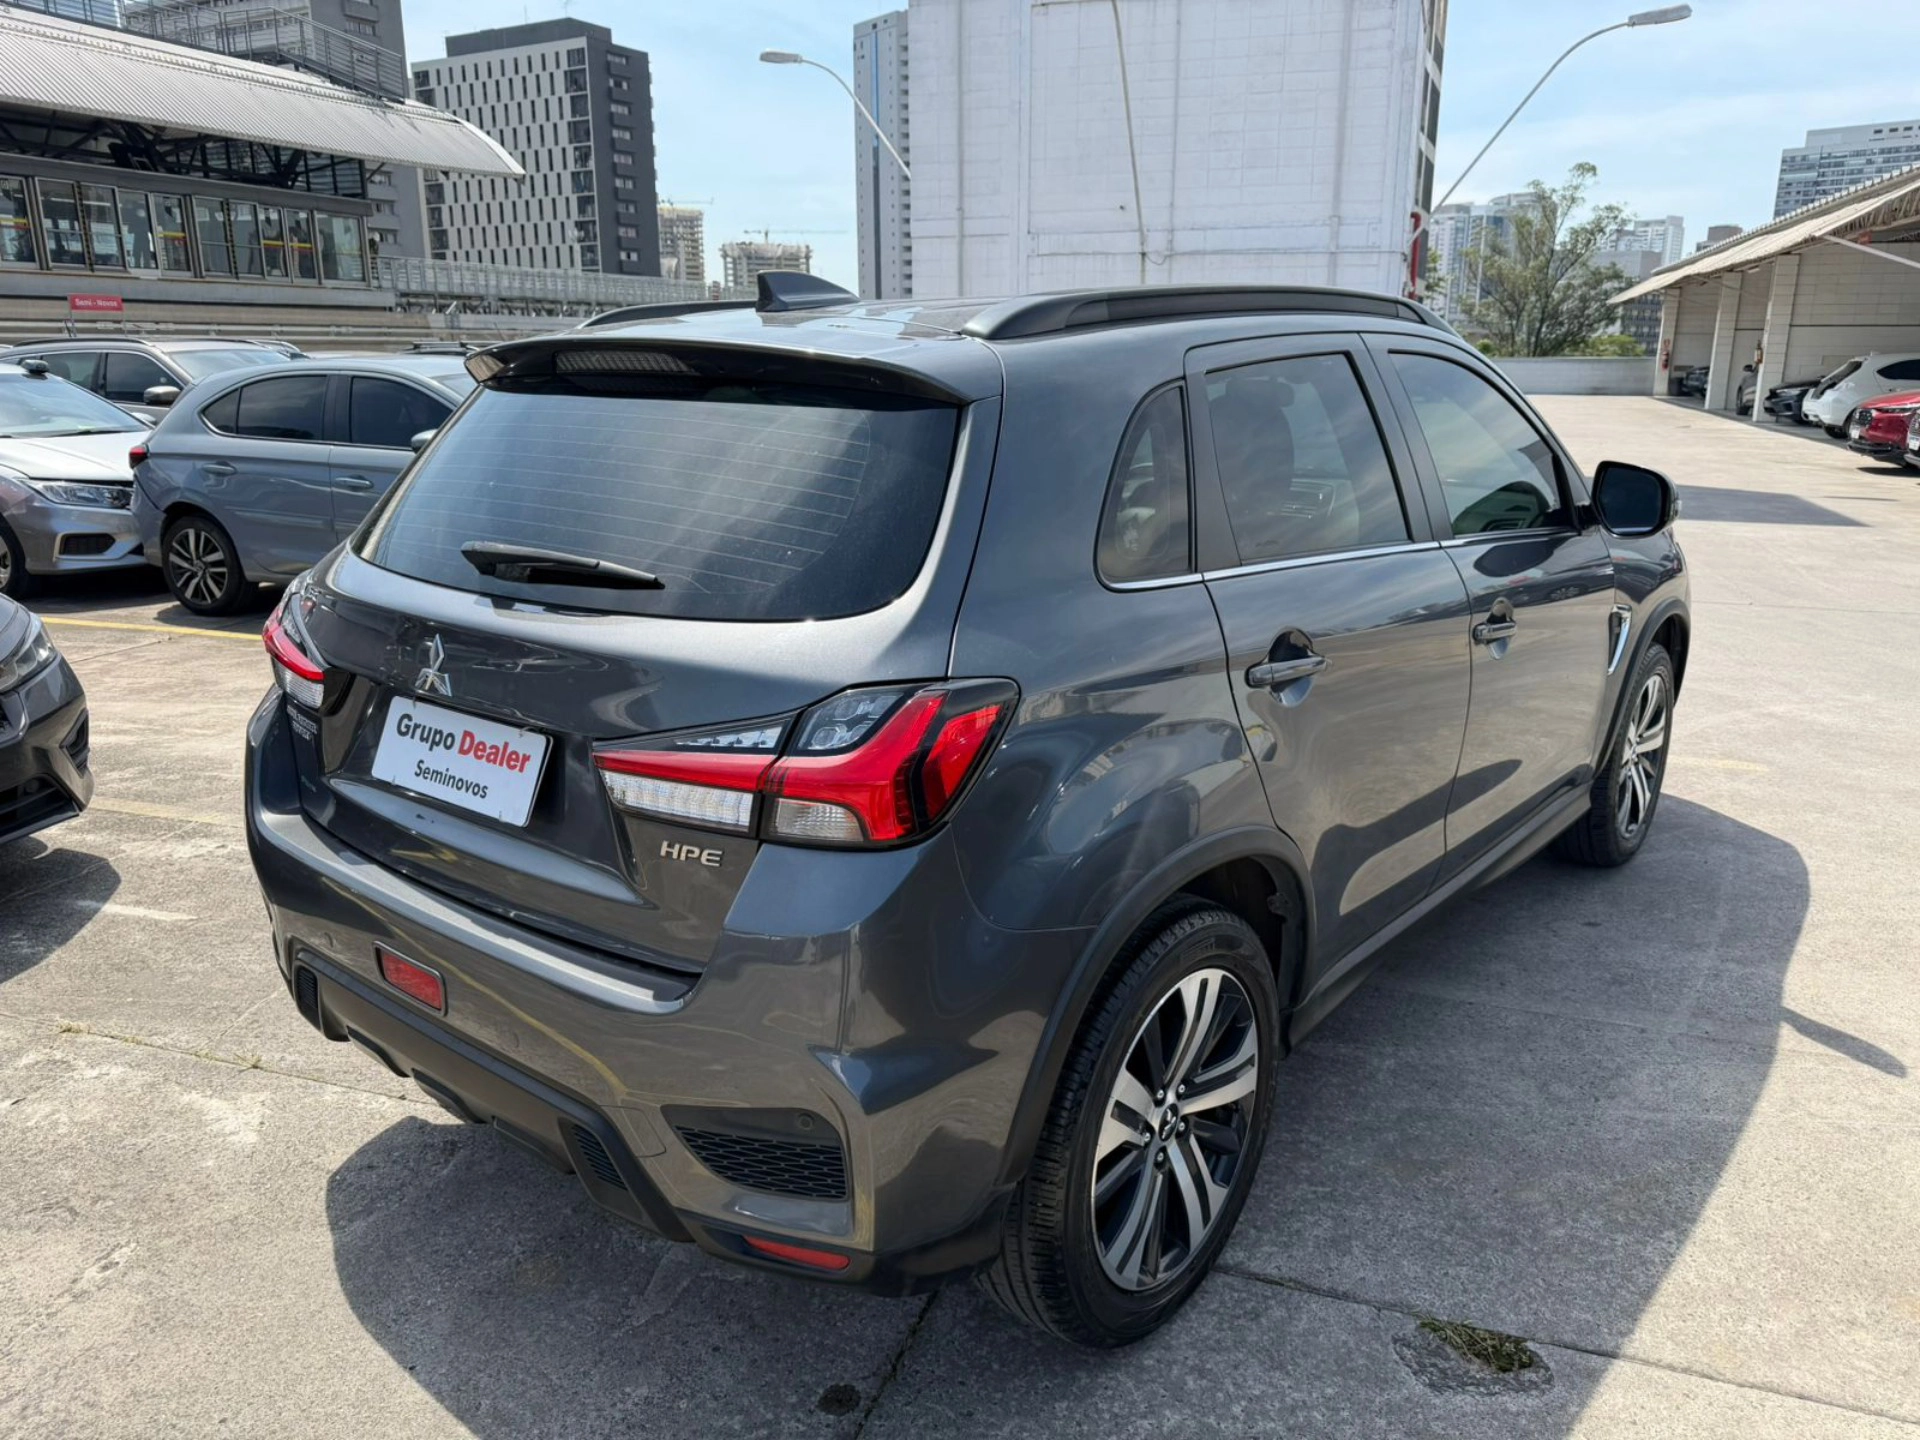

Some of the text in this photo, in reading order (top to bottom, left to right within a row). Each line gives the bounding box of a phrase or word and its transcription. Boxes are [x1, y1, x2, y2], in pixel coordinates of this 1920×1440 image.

[396, 713, 532, 774] Grupo Dealer
[414, 759, 489, 799] Seminovos
[660, 840, 723, 868] HPE
